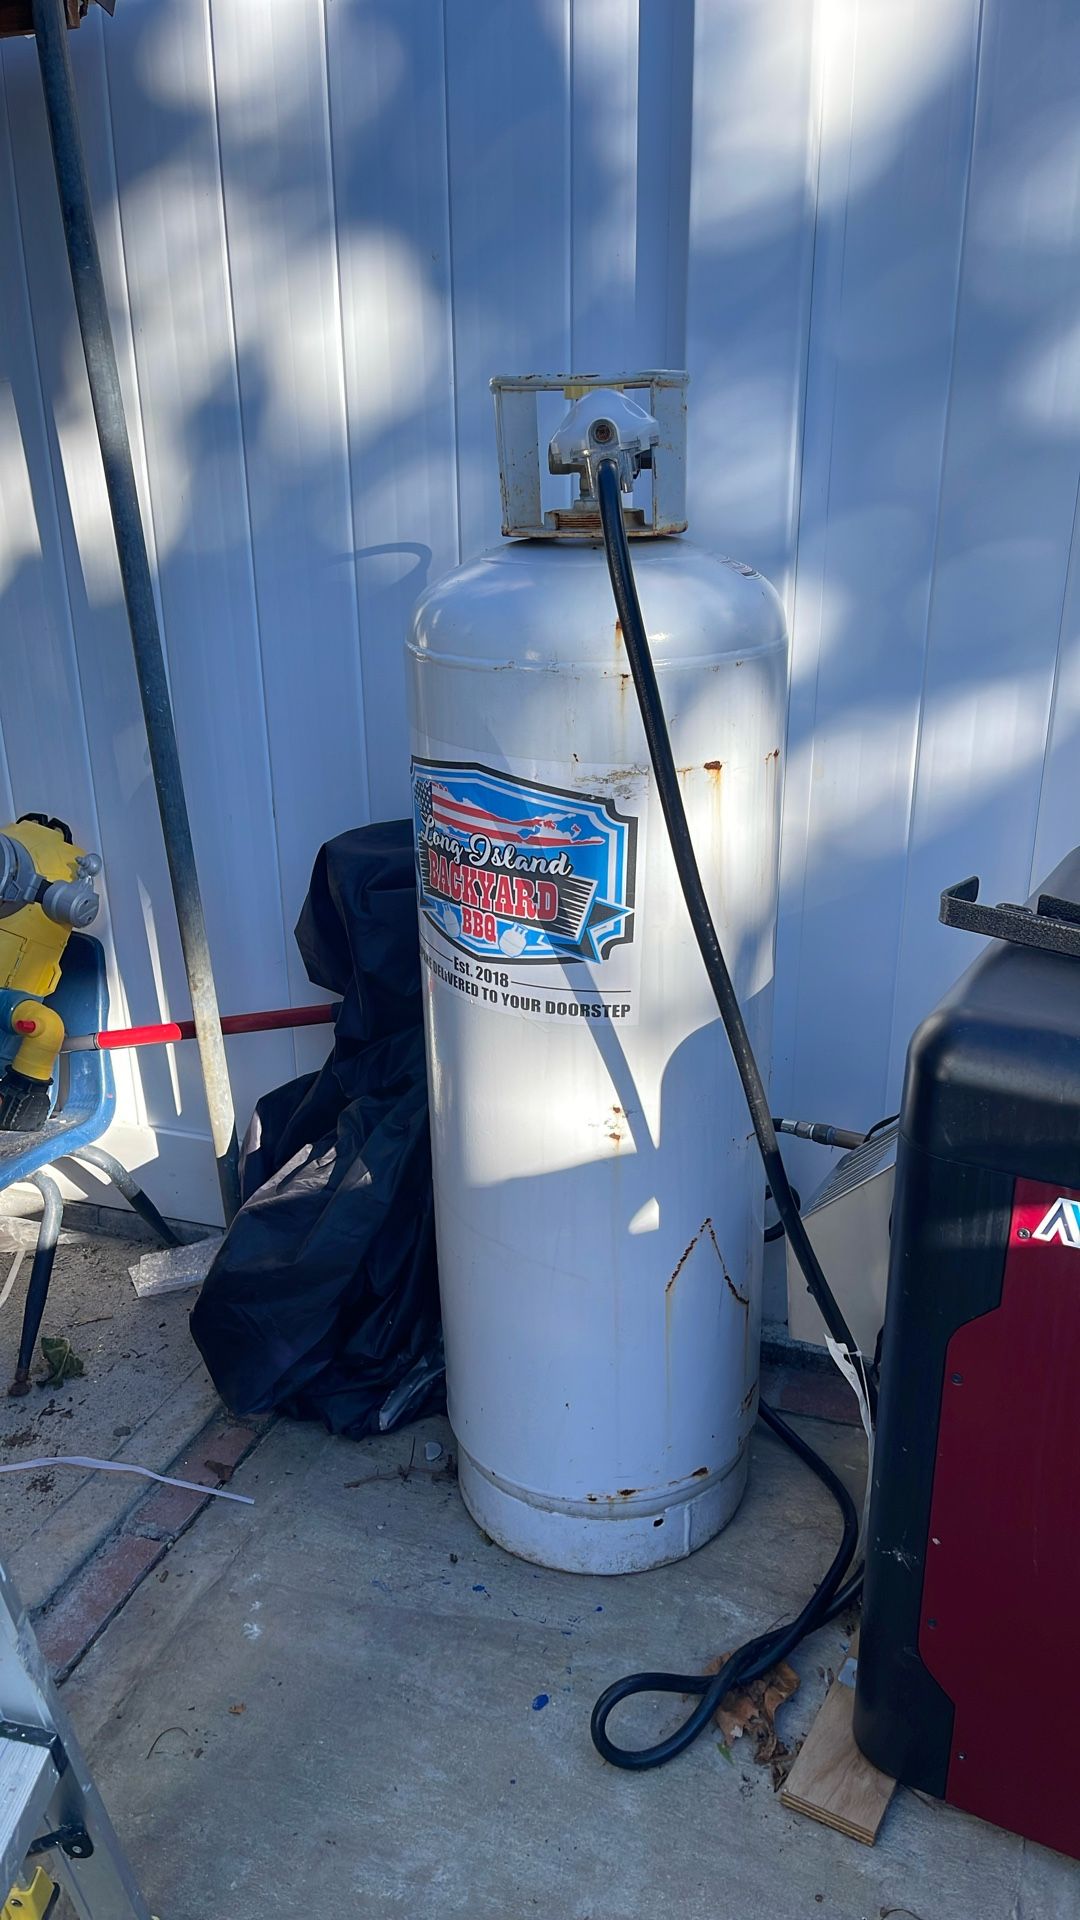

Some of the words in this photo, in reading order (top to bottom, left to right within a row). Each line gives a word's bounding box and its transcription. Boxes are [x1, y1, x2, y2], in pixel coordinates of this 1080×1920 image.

[420, 814, 465, 865] Long
[468, 833, 571, 876] Island
[428, 847, 559, 922] BACKYARD
[461, 904, 497, 945] BBQ
[433, 960, 479, 998] DELIVERED
[481, 986, 498, 1004] TO
[501, 992, 541, 1014] YOUR
[545, 1000, 631, 1019] DOORSTEP
[453, 956, 473, 978] Est.
[475, 966, 509, 988] 2018
